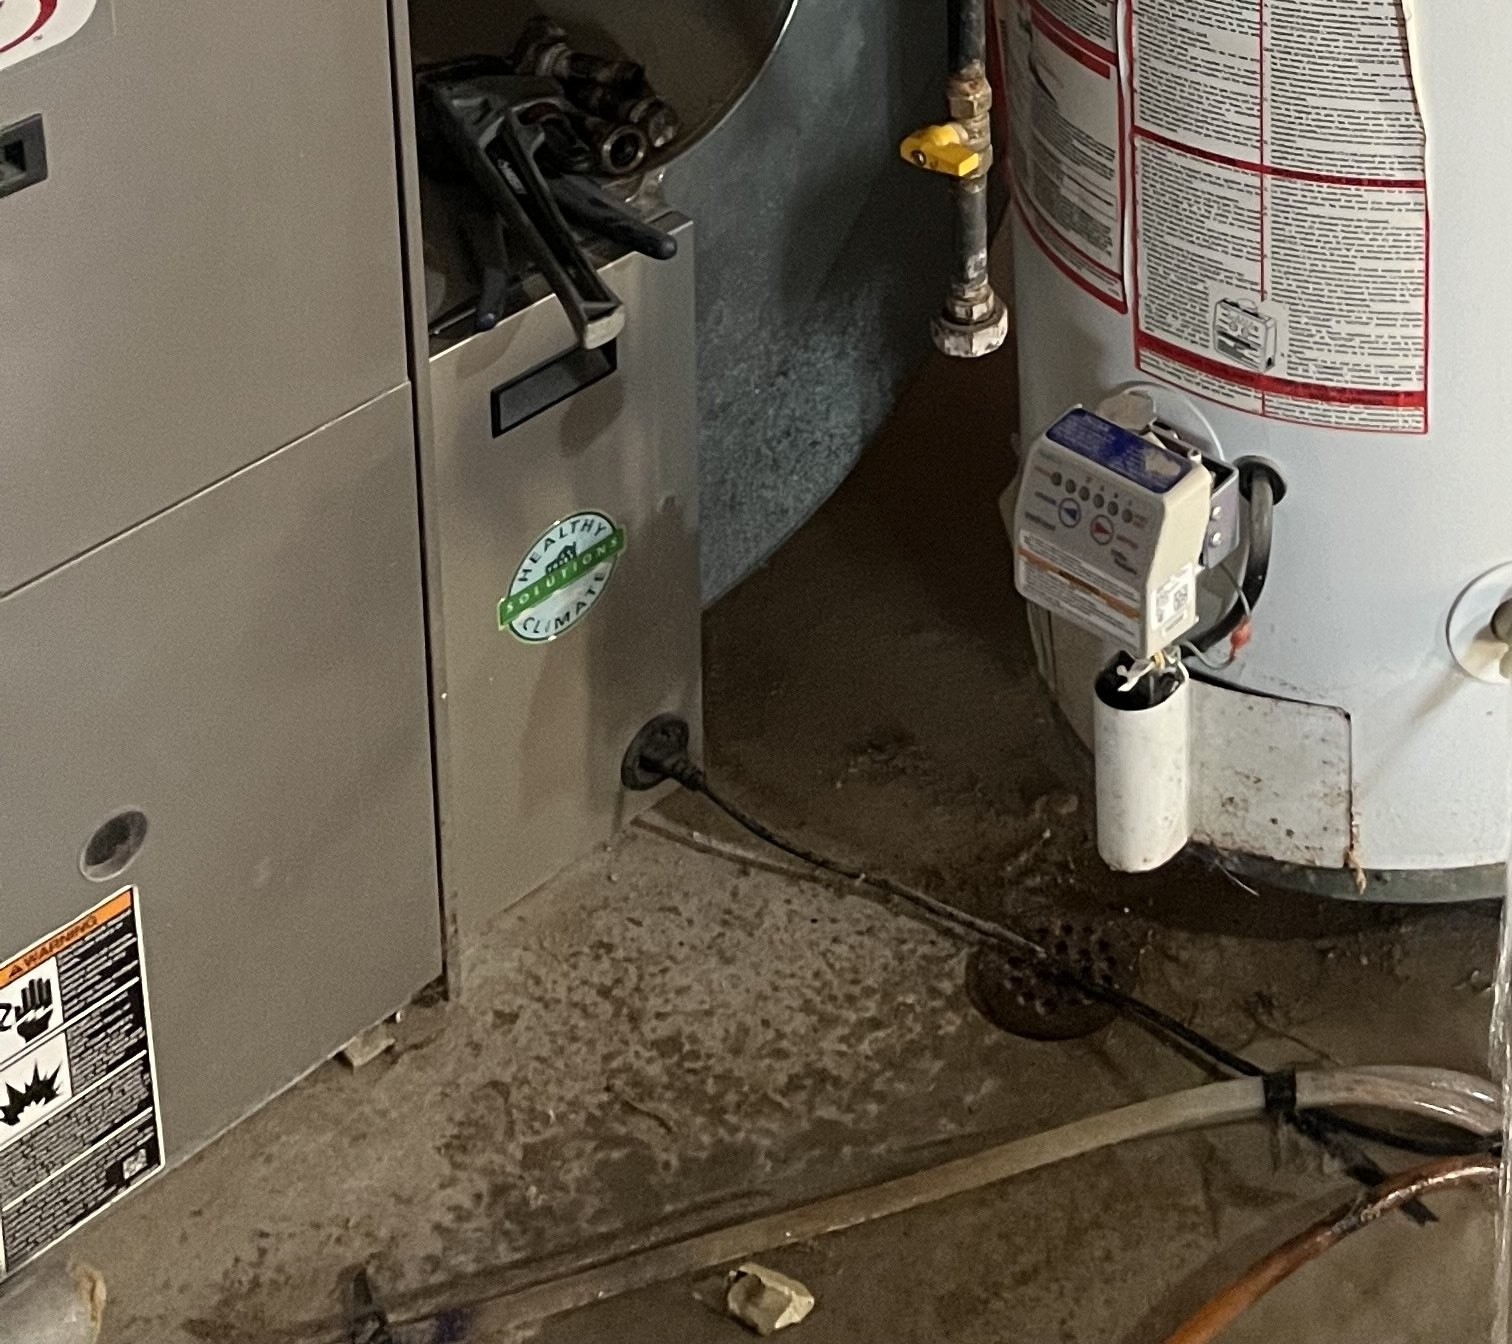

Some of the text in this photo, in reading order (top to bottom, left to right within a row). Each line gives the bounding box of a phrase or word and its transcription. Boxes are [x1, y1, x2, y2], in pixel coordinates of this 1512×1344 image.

[505, 536, 618, 614] SOLUTIONS
[518, 518, 607, 582] HEALTHY
[522, 571, 605, 634] CLIMATE
[23, 914, 98, 968] WARNING
